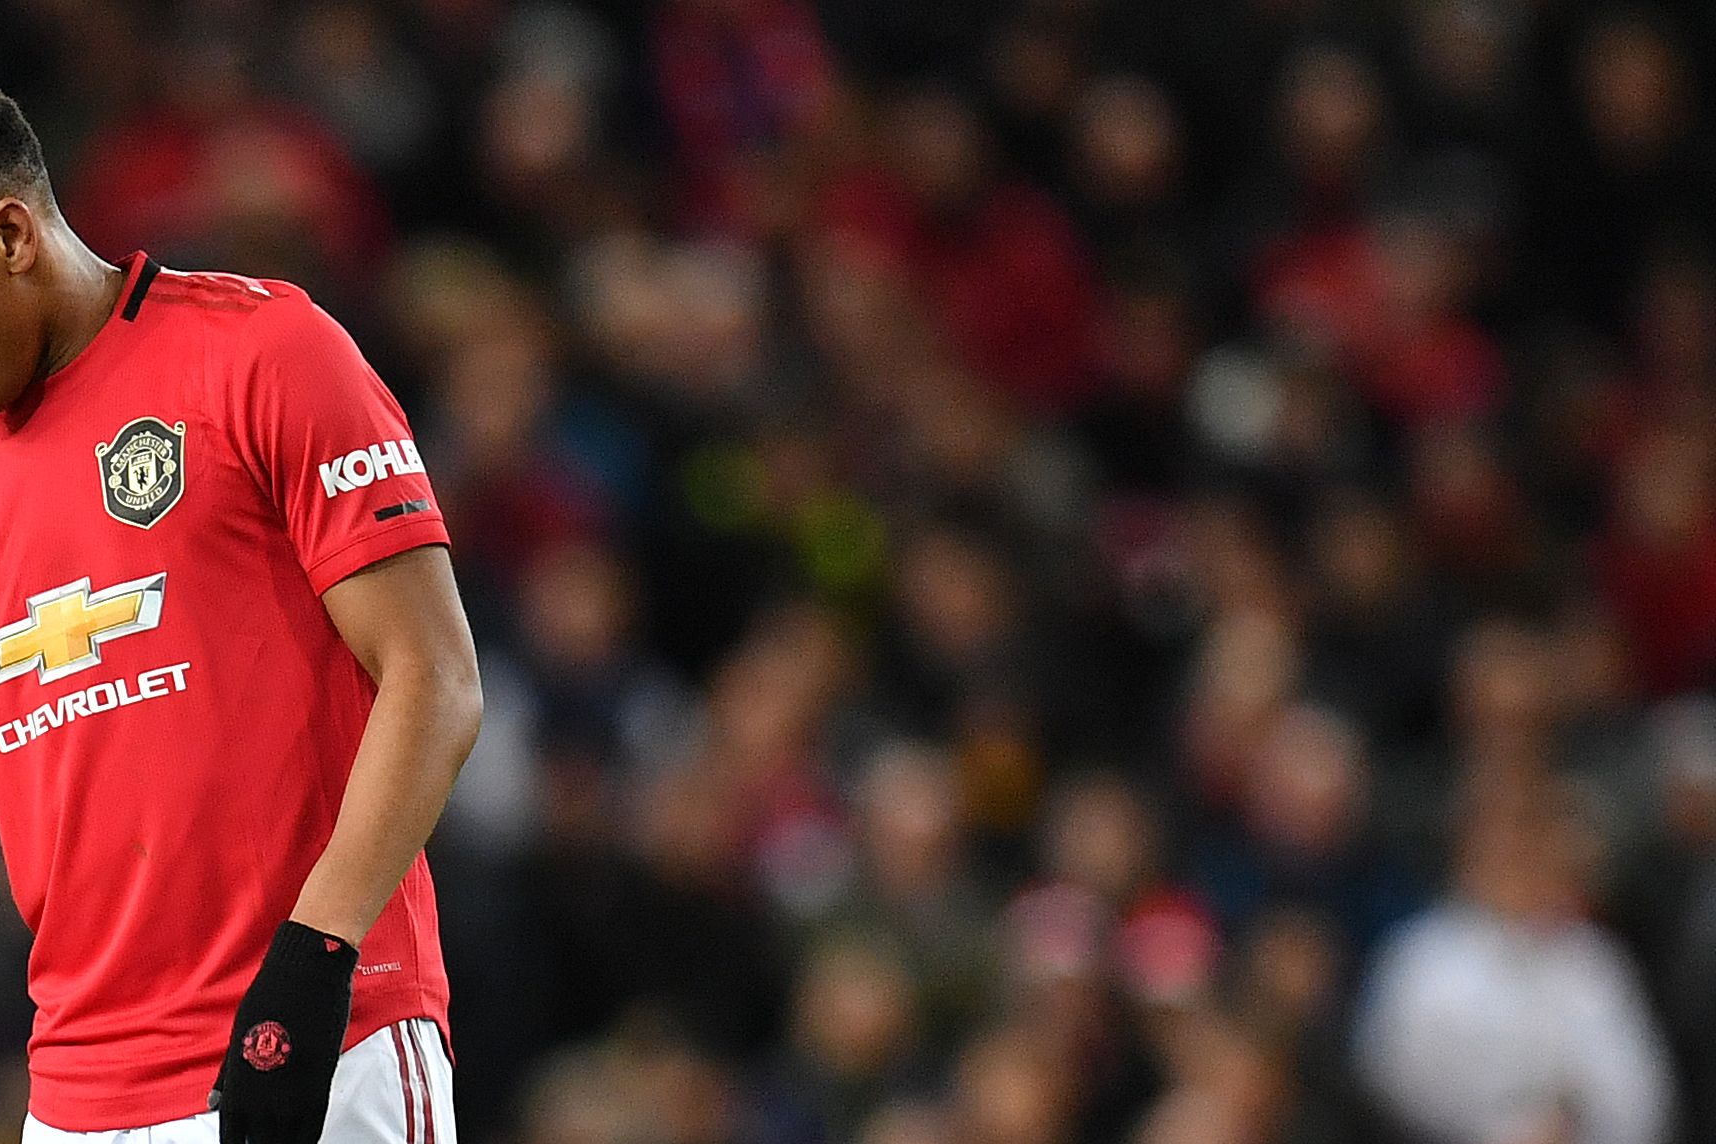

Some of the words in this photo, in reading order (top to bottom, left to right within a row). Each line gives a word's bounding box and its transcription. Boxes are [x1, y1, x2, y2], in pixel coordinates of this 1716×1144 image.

[115, 437, 169, 469] MANCHESTER
[318, 439, 426, 498] KOHLE
[125, 486, 163, 505] UNITED
